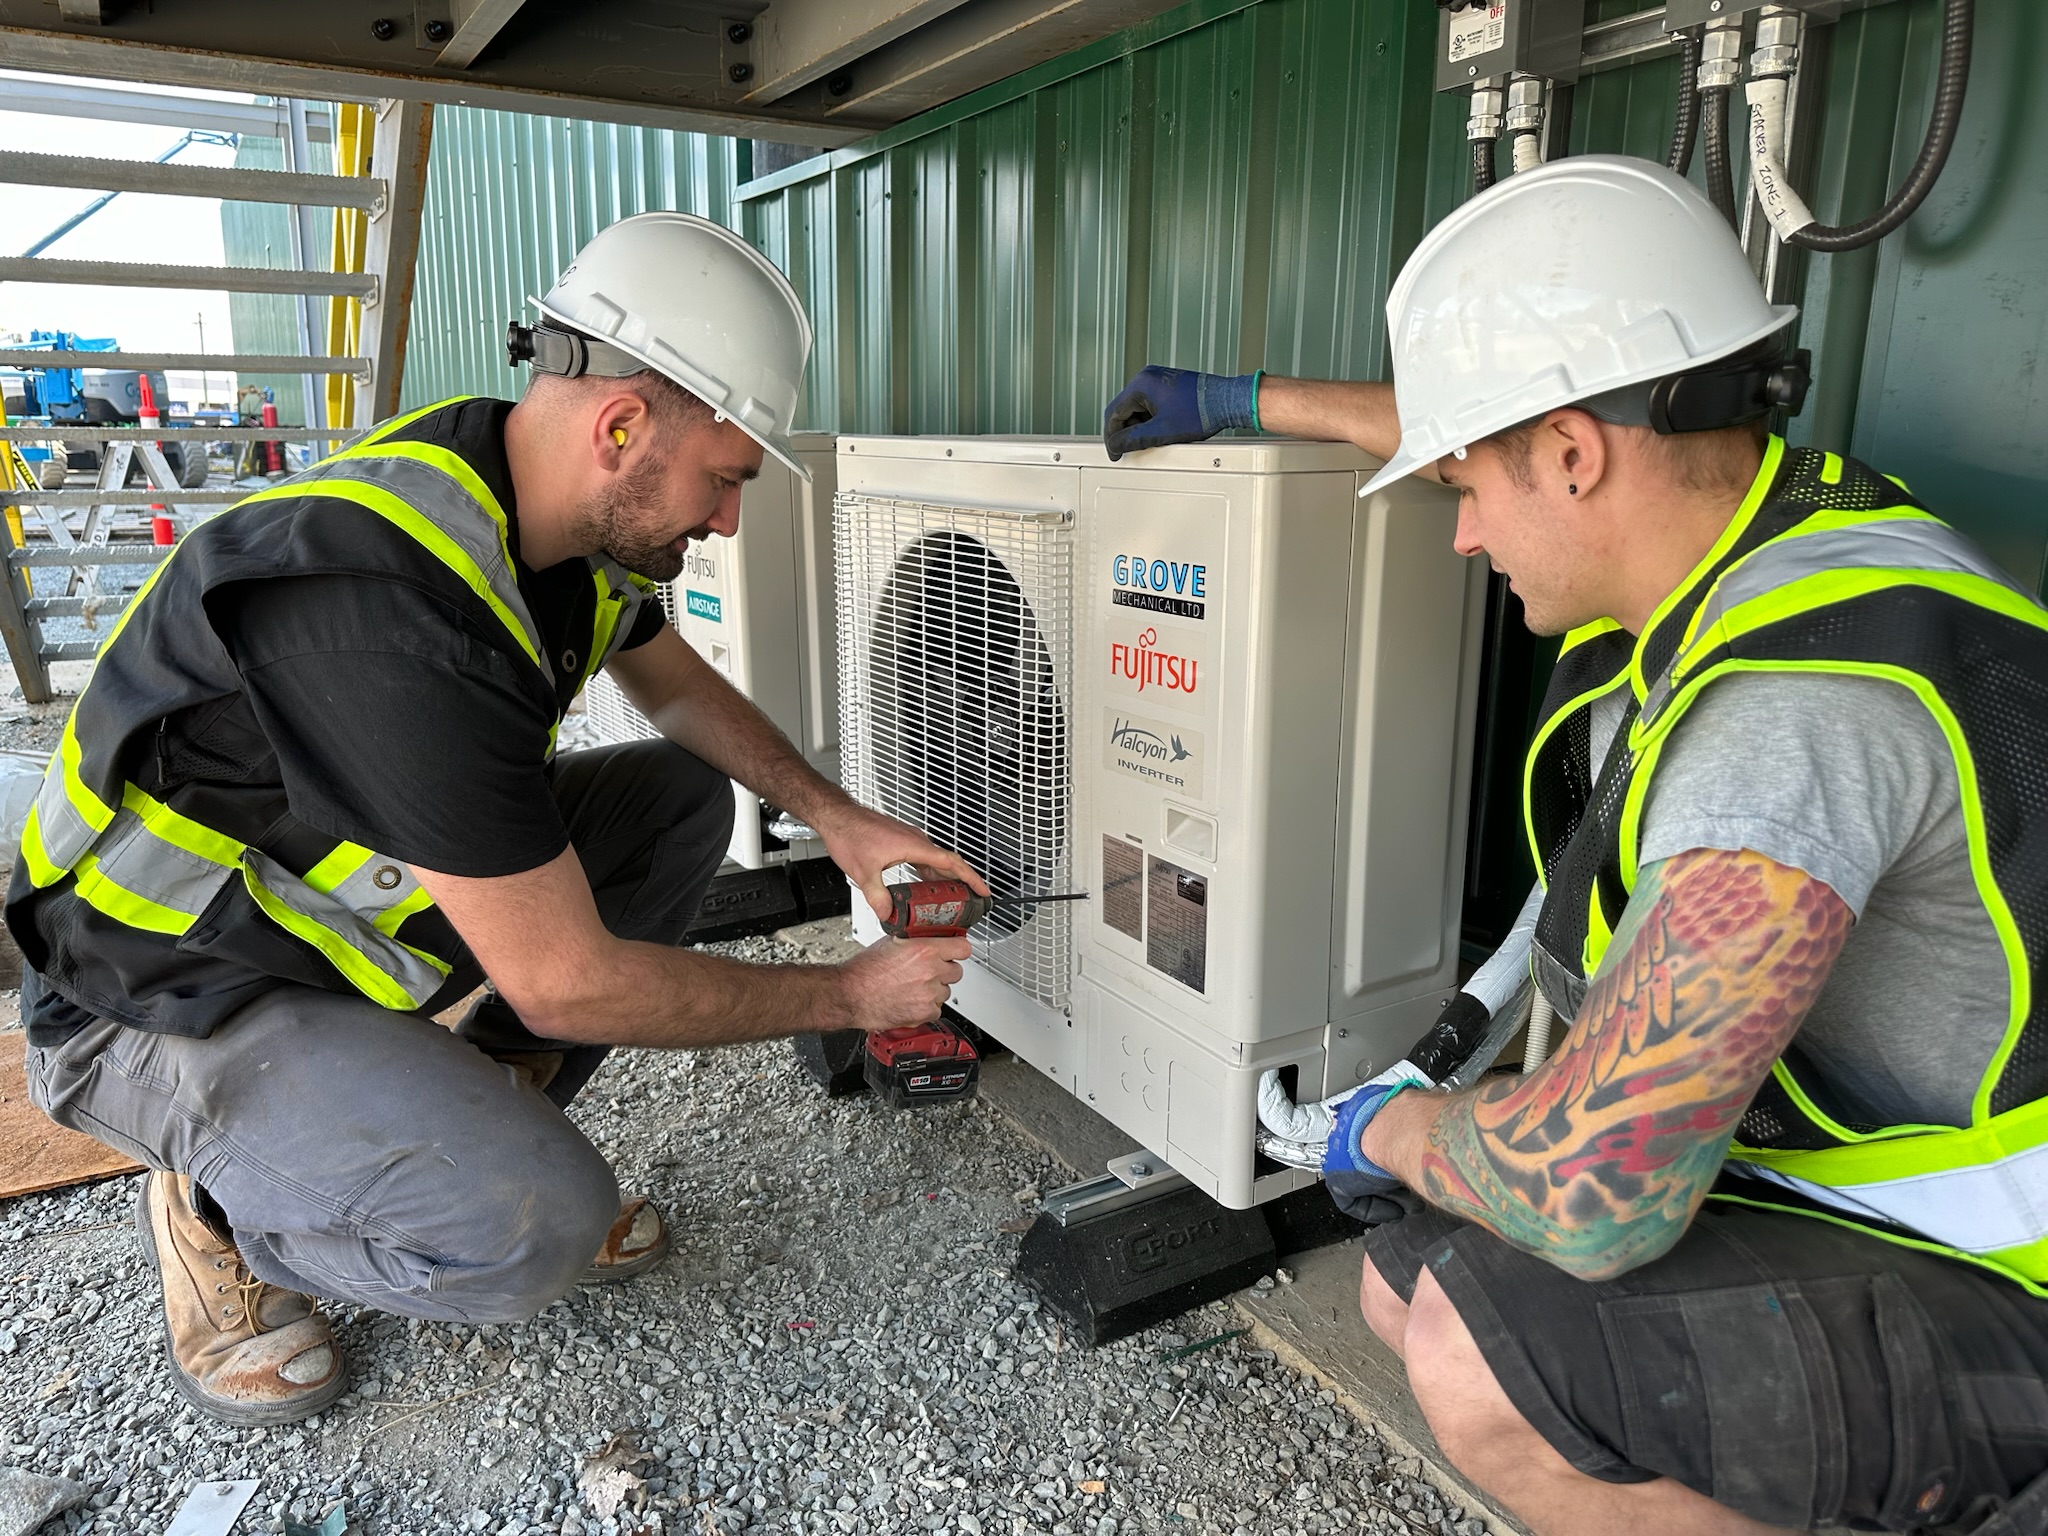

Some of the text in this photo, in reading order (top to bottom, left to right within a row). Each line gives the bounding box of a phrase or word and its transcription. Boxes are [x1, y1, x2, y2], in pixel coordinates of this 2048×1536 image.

[1490, 6, 1504, 19] OFF
[1751, 103, 1787, 220] STACKER ZONE 1
[687, 555, 716, 580] FUJITSU
[1112, 554, 1207, 598] GROVE
[688, 596, 720, 618] AIRSTAGE
[1113, 589, 1178, 614] MECHANICAL
[1111, 642, 1198, 693] FUJITSU
[1111, 716, 1168, 760] Halcyon
[1117, 758, 1185, 788] INVERTER
